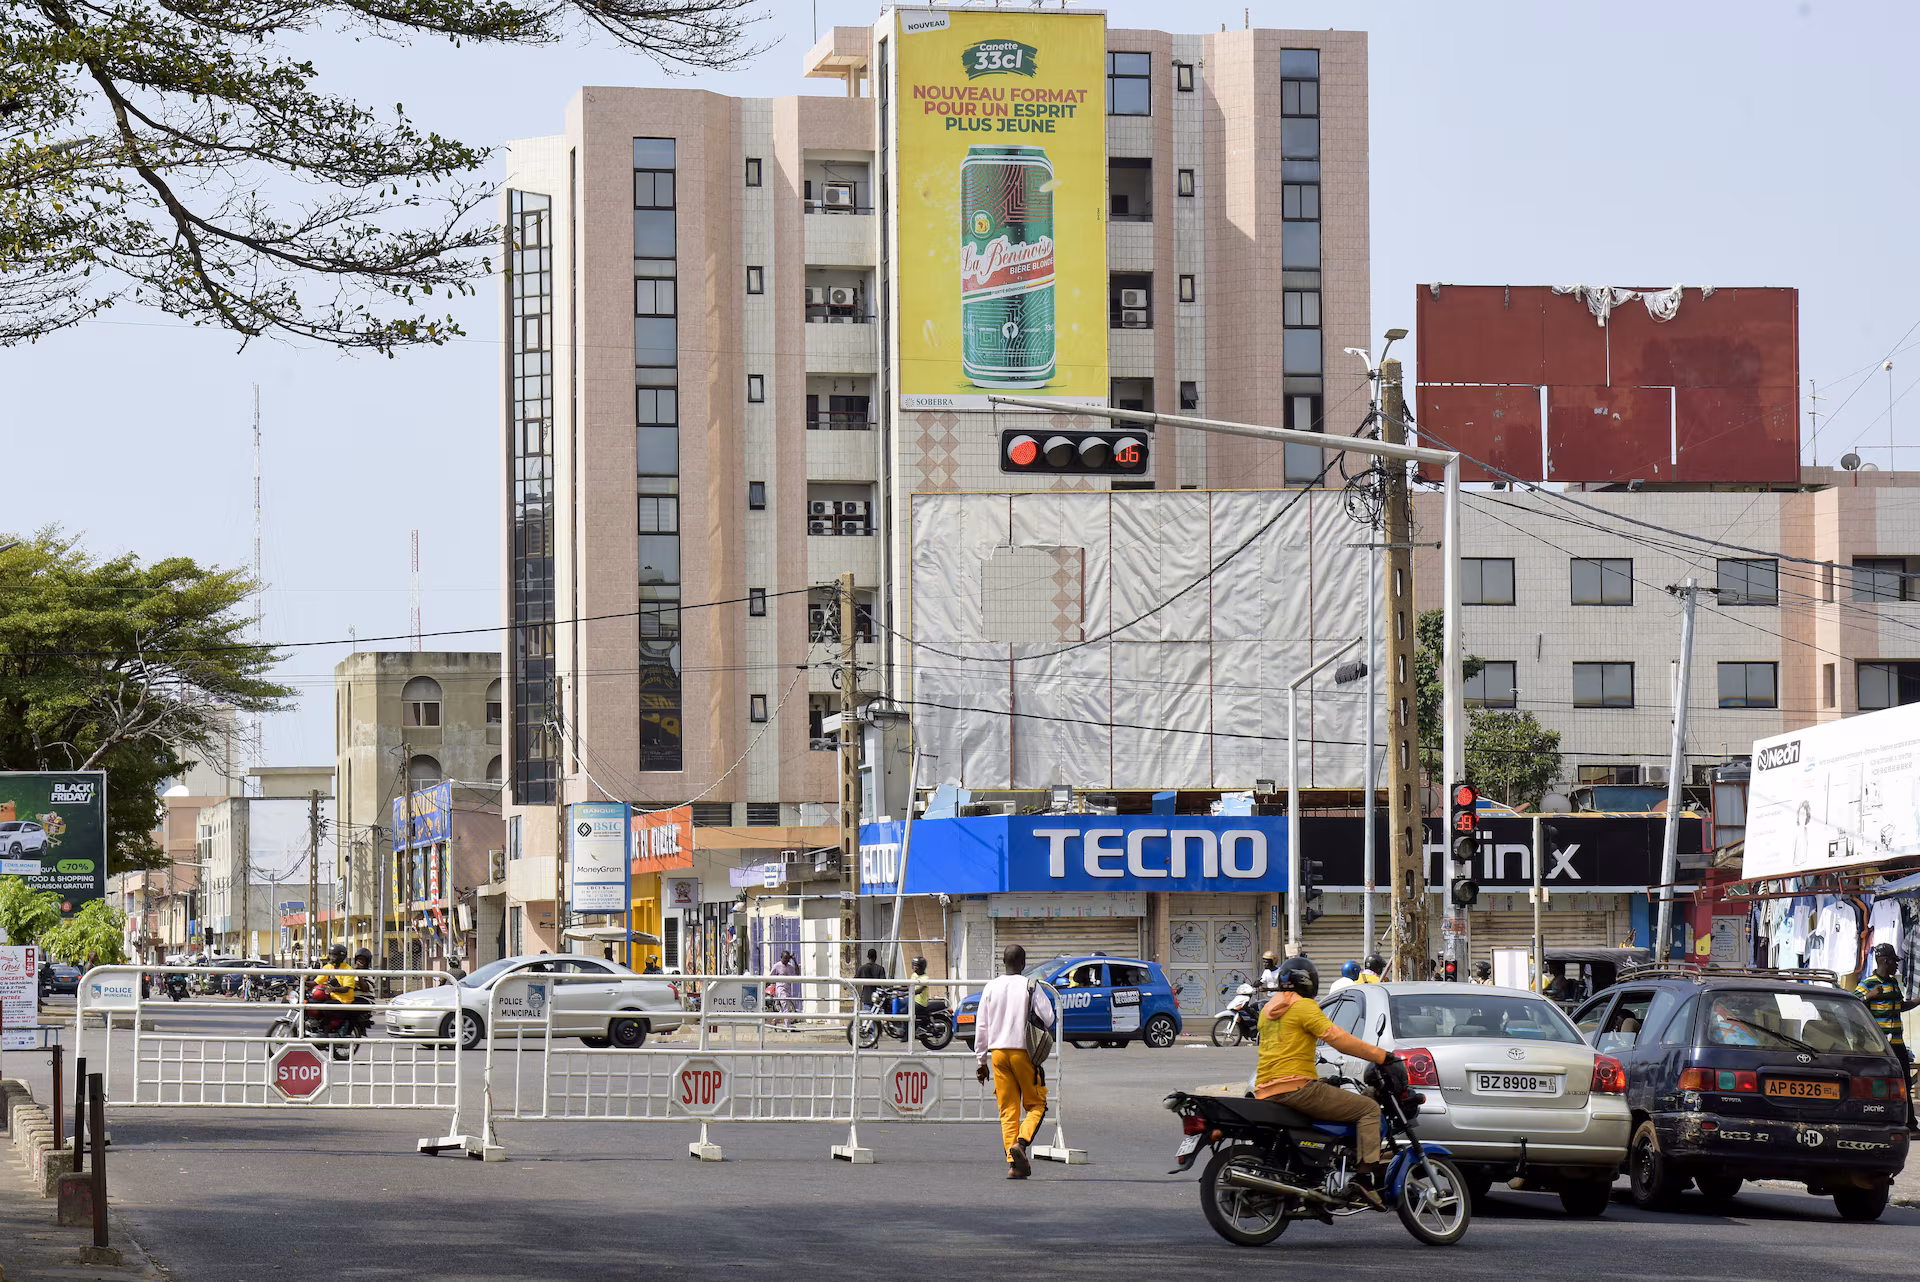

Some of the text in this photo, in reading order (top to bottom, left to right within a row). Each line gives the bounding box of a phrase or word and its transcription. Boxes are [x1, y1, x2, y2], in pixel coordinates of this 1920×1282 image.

[908, 20, 945, 30] NOUVEAU
[979, 42, 1019, 51] Canette
[974, 50, 1022, 70] 33cl
[913, 85, 1088, 103] NOUVEAU FORMAT
[924, 101, 1077, 118] POUR UN ESPRIT
[945, 117, 1056, 133] PLUS JEUNE
[962, 240, 1052, 277] La Béninoise
[1009, 256, 1054, 275] BIÈRE BLONDE
[916, 398, 954, 406] SOBEBRA
[54, 783, 90, 793] BLACK
[51, 793, 88, 801] FRIDAY
[593, 821, 622, 831] BSIC
[1033, 828, 1268, 879] TECNO
[41, 865, 57, 873] QU'À
[62, 863, 89, 871] -70%
[860, 843, 898, 884] ECNO
[499, 997, 523, 1006] POLICE
[713, 997, 736, 1006] POLICE
[501, 1008, 541, 1018] MUNICIPALE
[279, 1065, 320, 1080] STOP
[681, 1070, 722, 1105] STOP
[895, 1071, 928, 1104] STOP
[1481, 1075, 1537, 1090] BZ 8908
[1769, 1081, 1822, 1097] AP 6326
[1863, 1104, 1885, 1113] picnic
